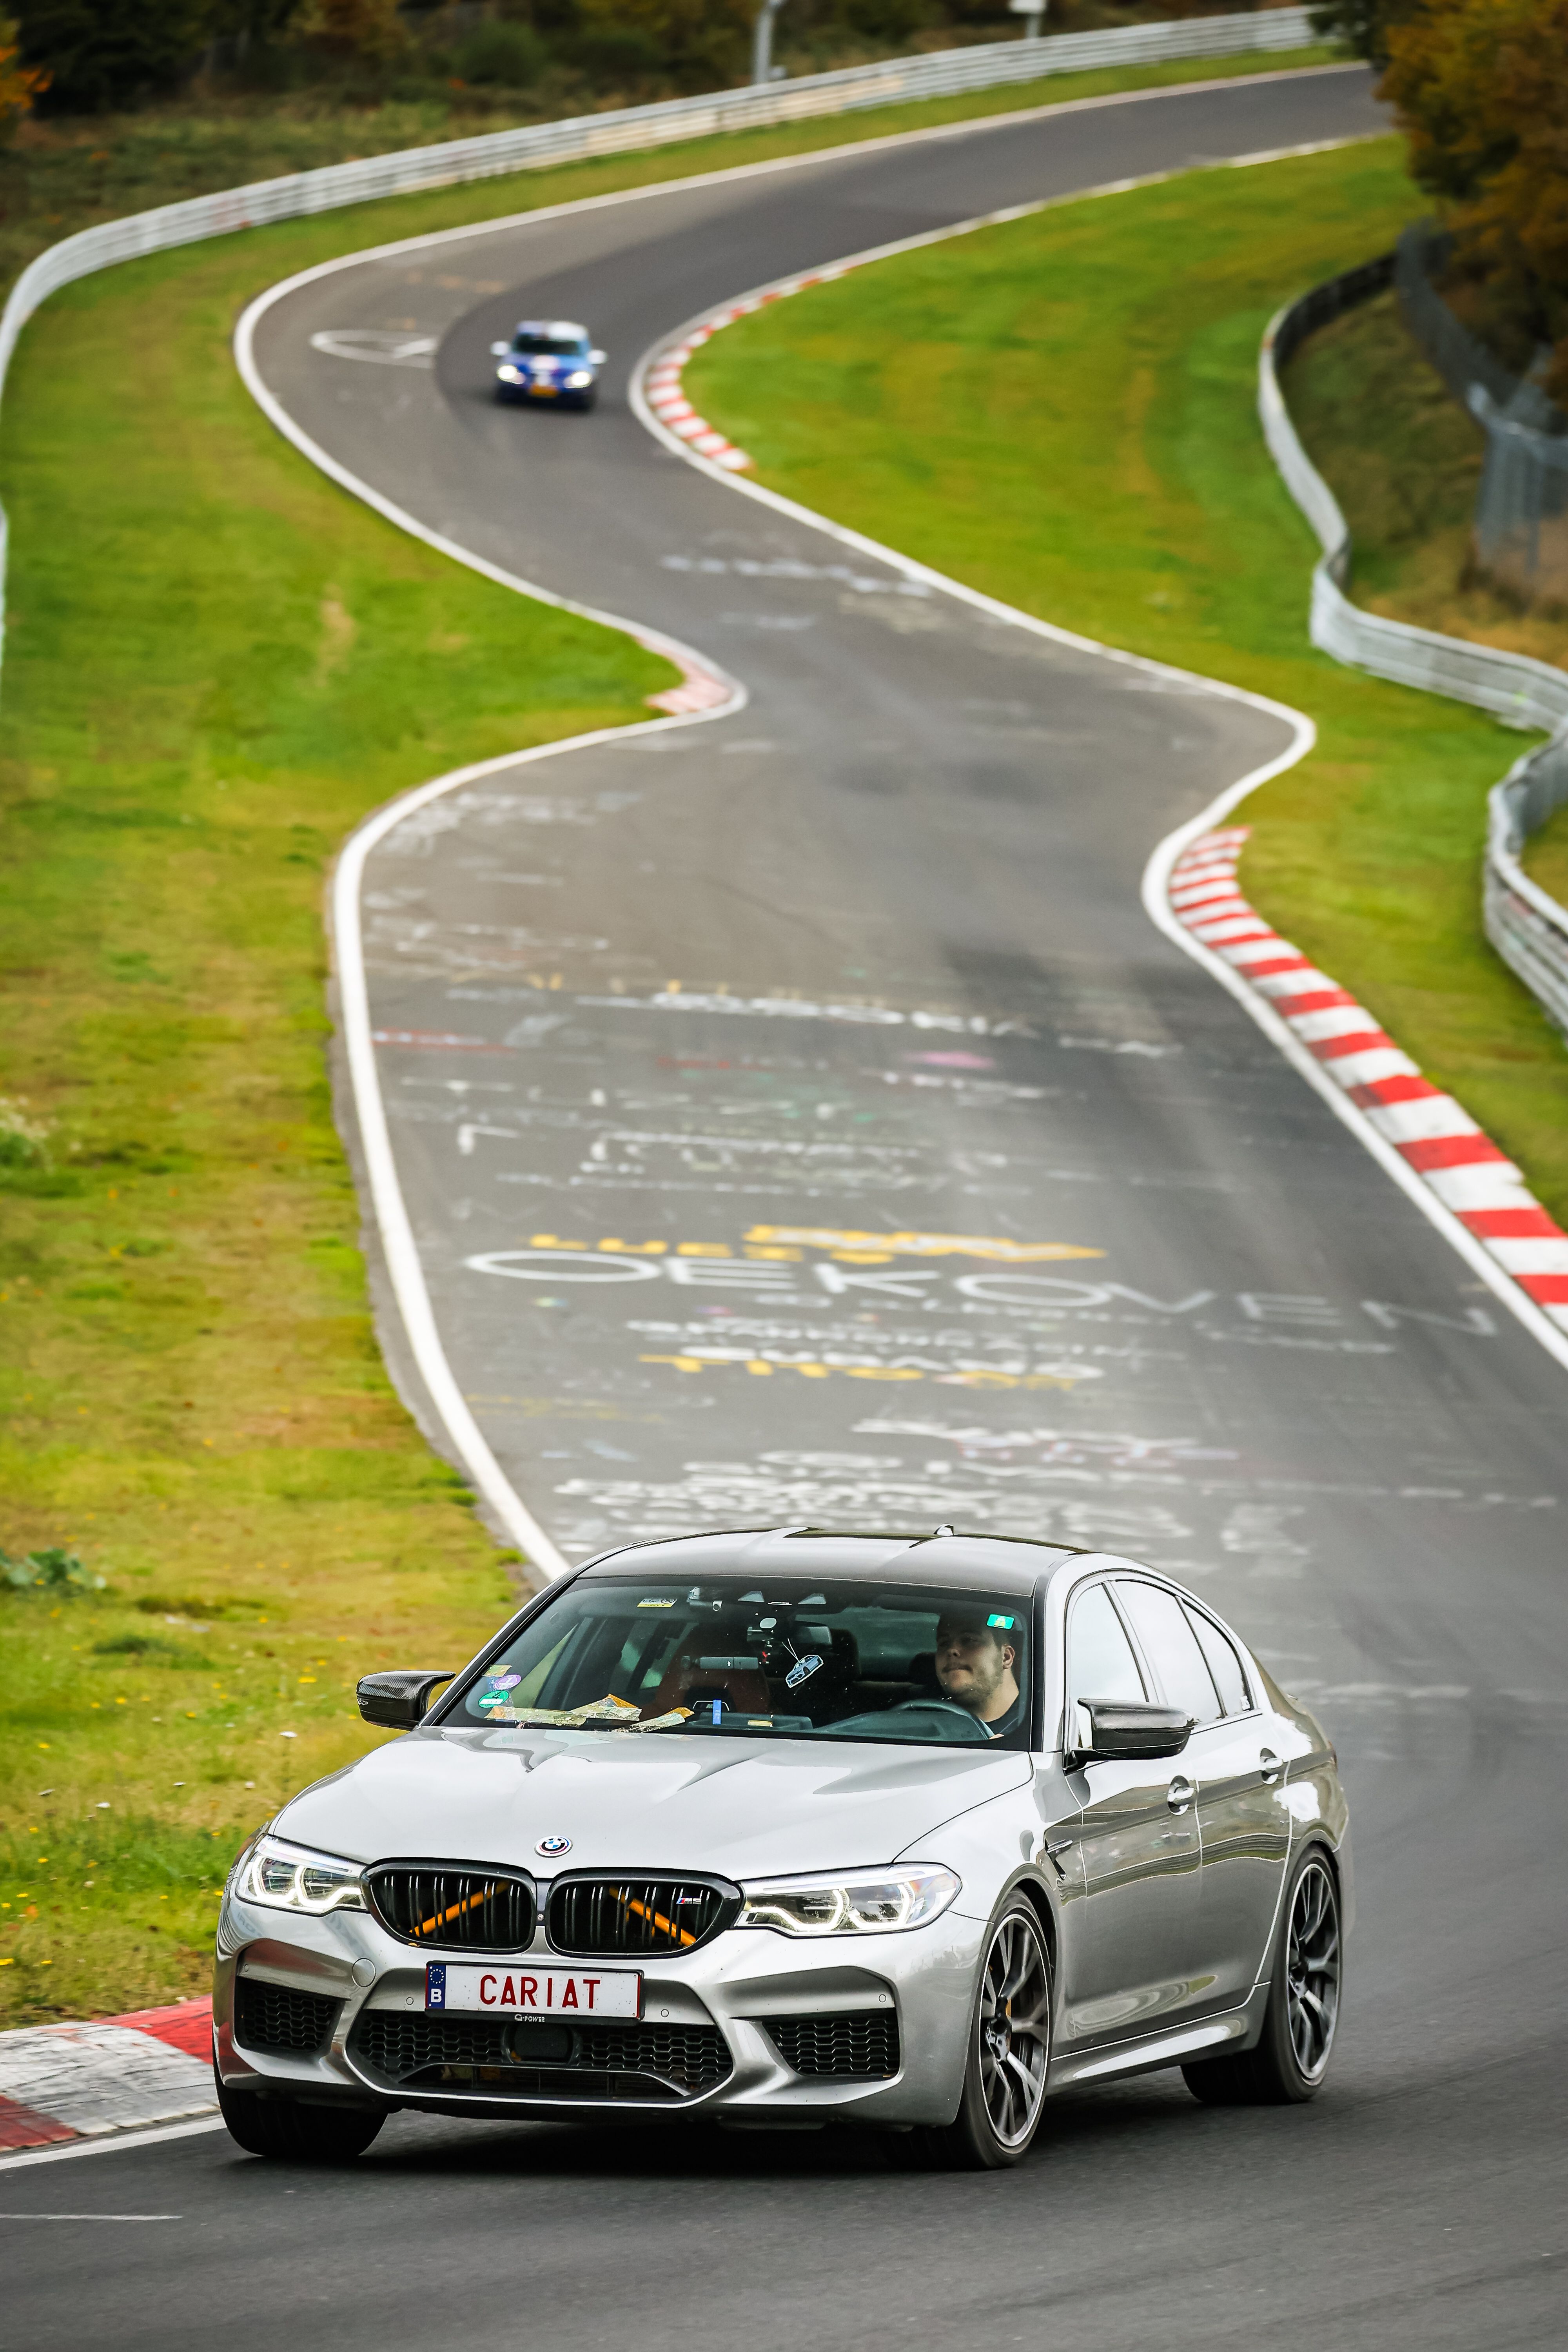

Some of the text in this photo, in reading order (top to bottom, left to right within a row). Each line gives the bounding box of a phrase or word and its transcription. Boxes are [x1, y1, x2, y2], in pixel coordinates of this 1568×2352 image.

[465, 1250, 1498, 1337] OEKOVEN
[431, 1989, 442, 2003] B
[480, 1975, 601, 2009] CARIAT
